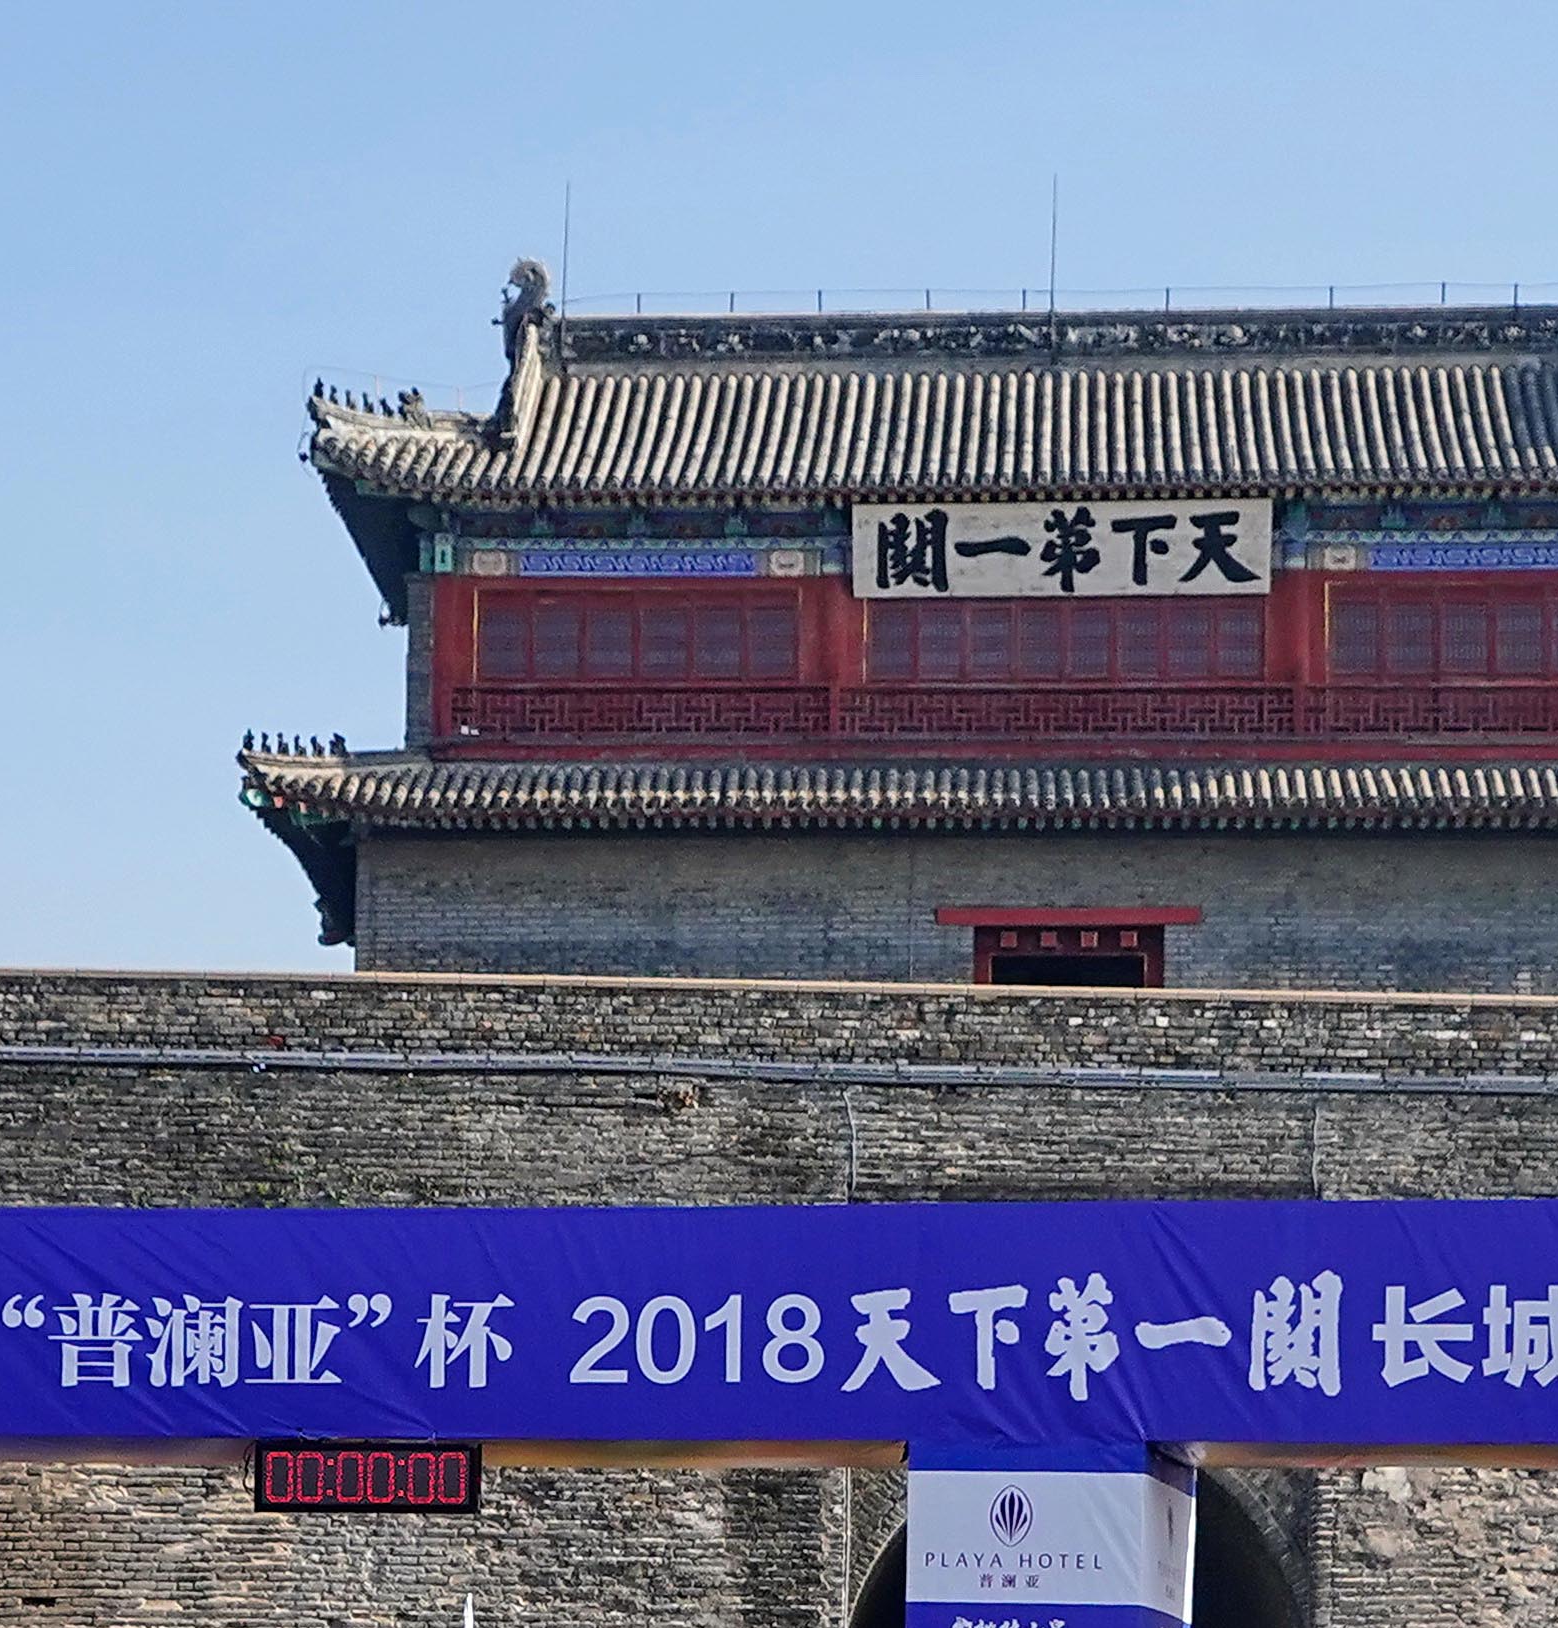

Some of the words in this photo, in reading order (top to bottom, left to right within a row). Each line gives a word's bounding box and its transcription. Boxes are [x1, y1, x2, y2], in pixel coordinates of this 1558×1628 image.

[265, 1450, 470, 1504] 00:00:00
[925, 1552, 1004, 1569] PLAYA
[1019, 1553, 1103, 1571] HOTEL
